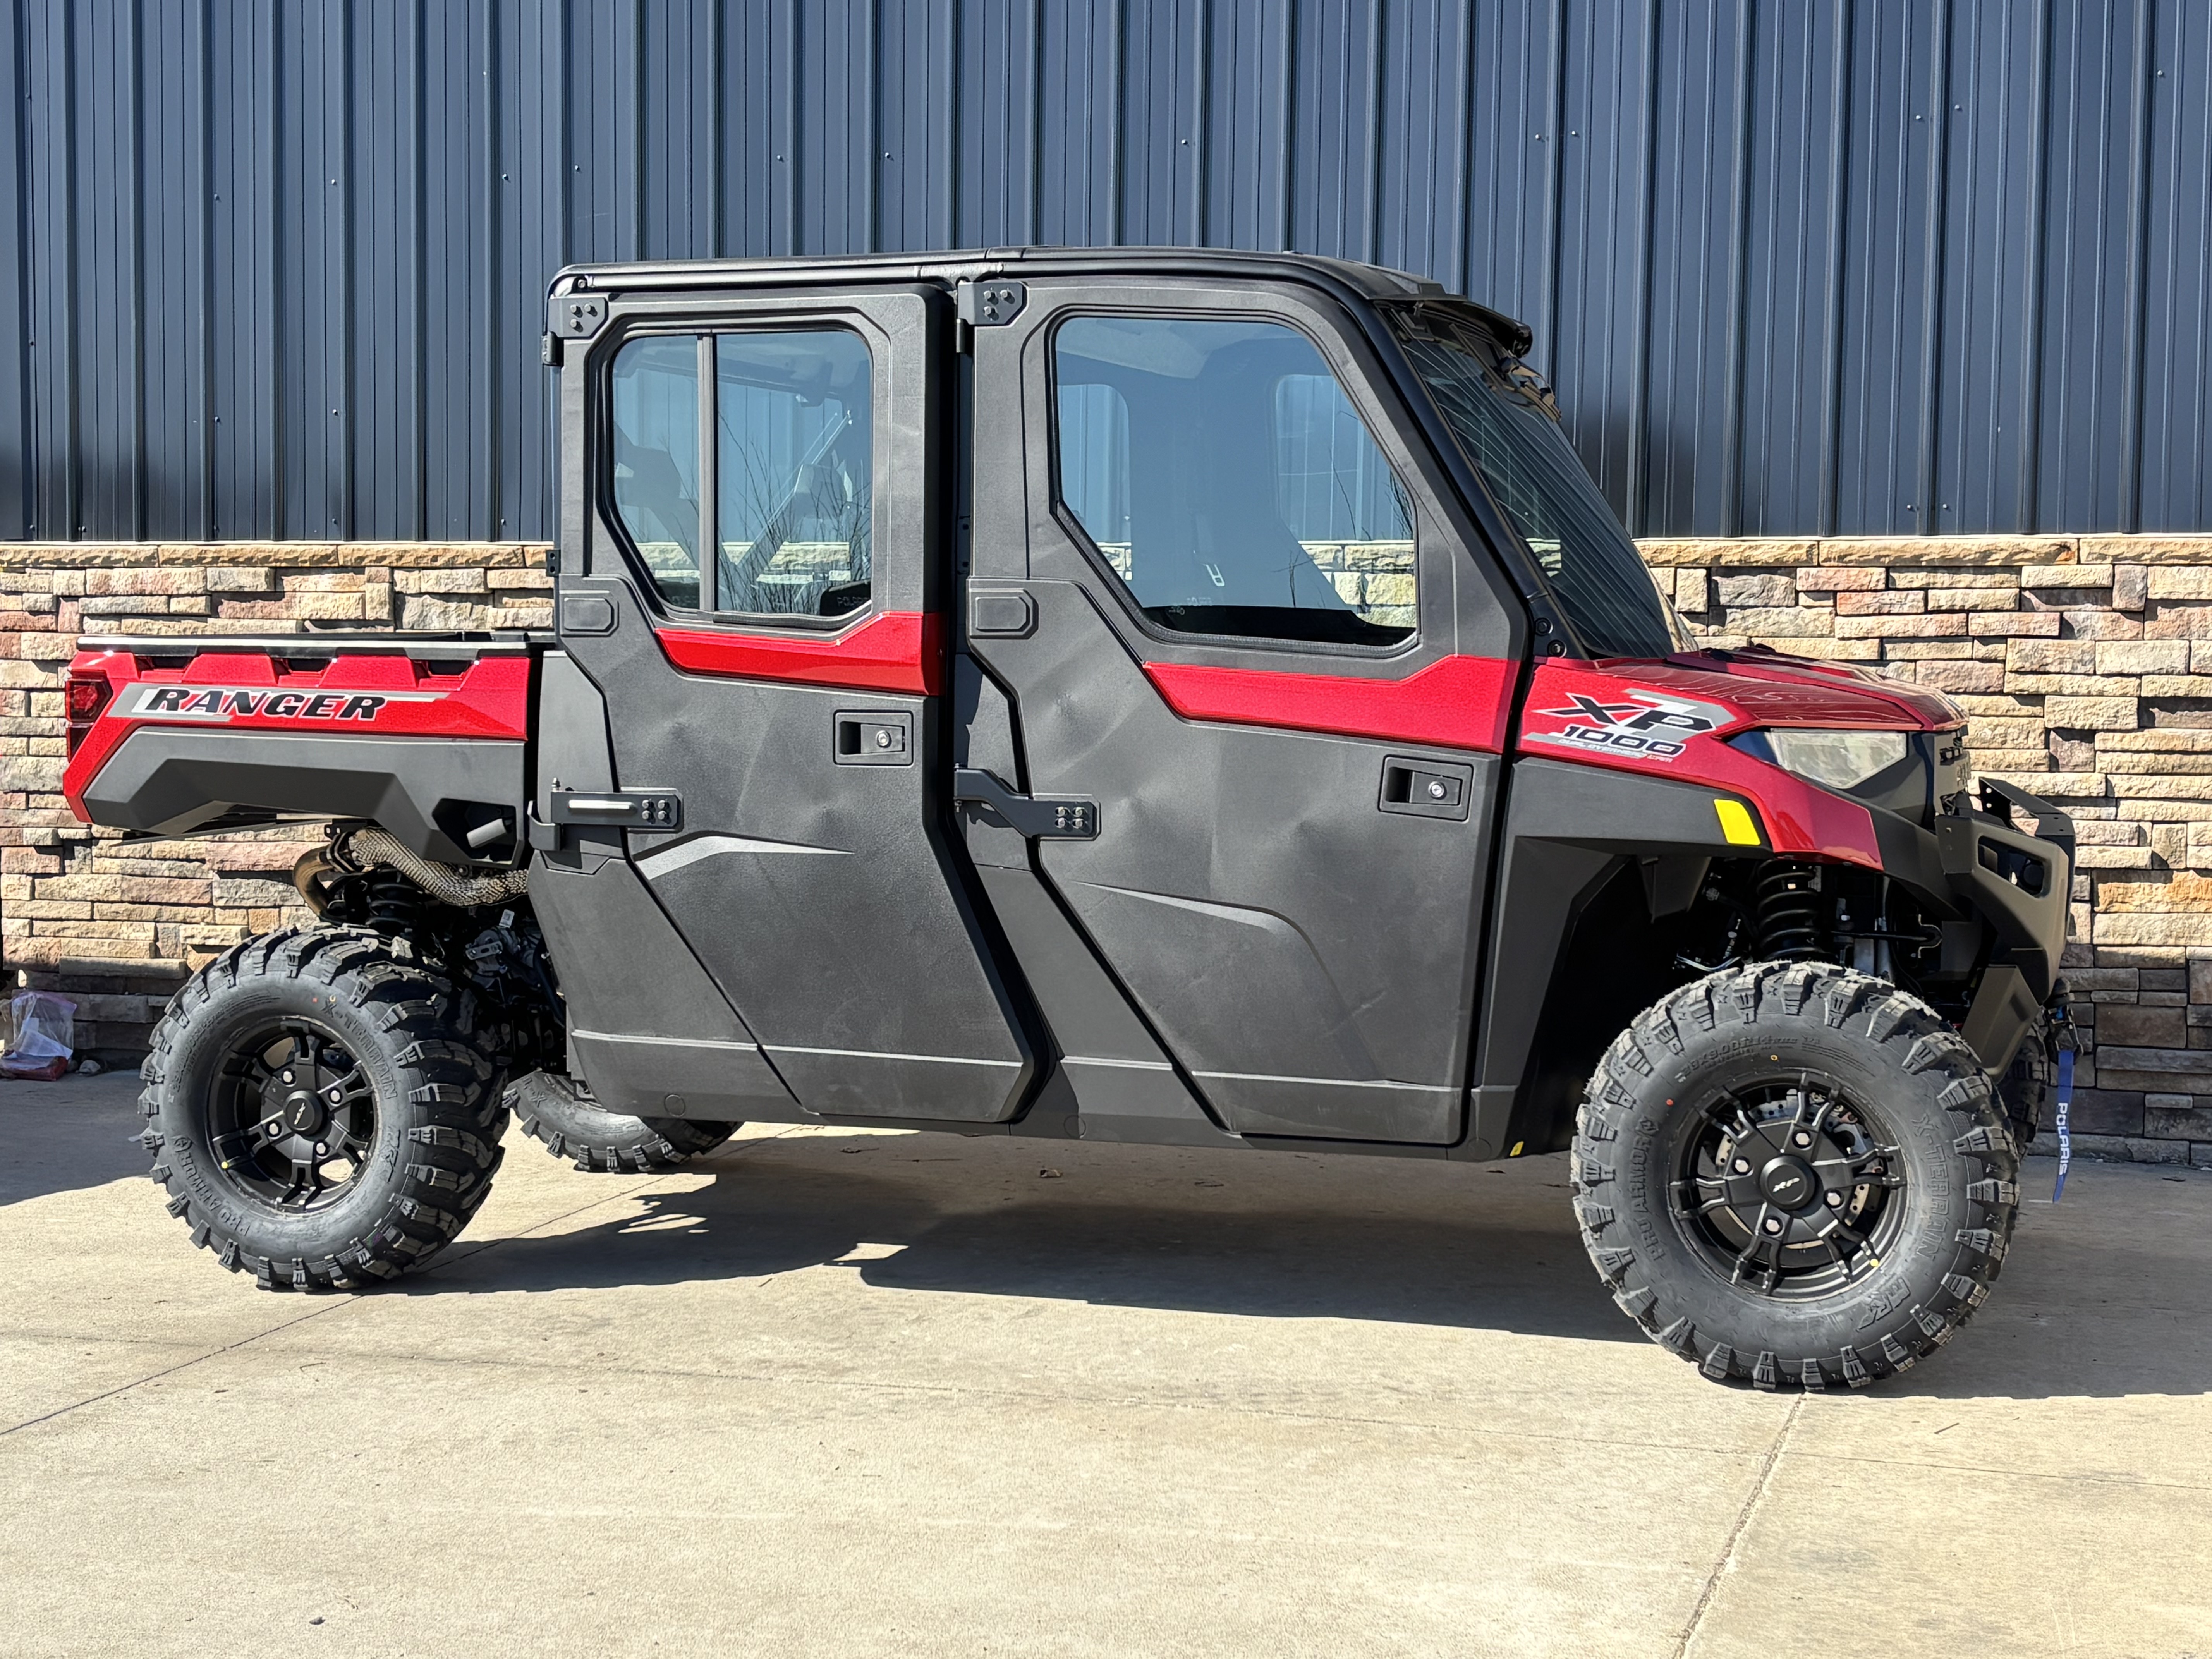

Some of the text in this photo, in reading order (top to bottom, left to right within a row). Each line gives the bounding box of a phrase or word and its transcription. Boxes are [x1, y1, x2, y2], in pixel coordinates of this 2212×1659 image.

[146, 687, 386, 721] RANGER
[1532, 692, 1716, 732] XP
[1562, 723, 1686, 758] 1000
[2056, 1103, 2070, 1175] POLARIS
[1911, 1112, 1950, 1259] X-TERRAIN
